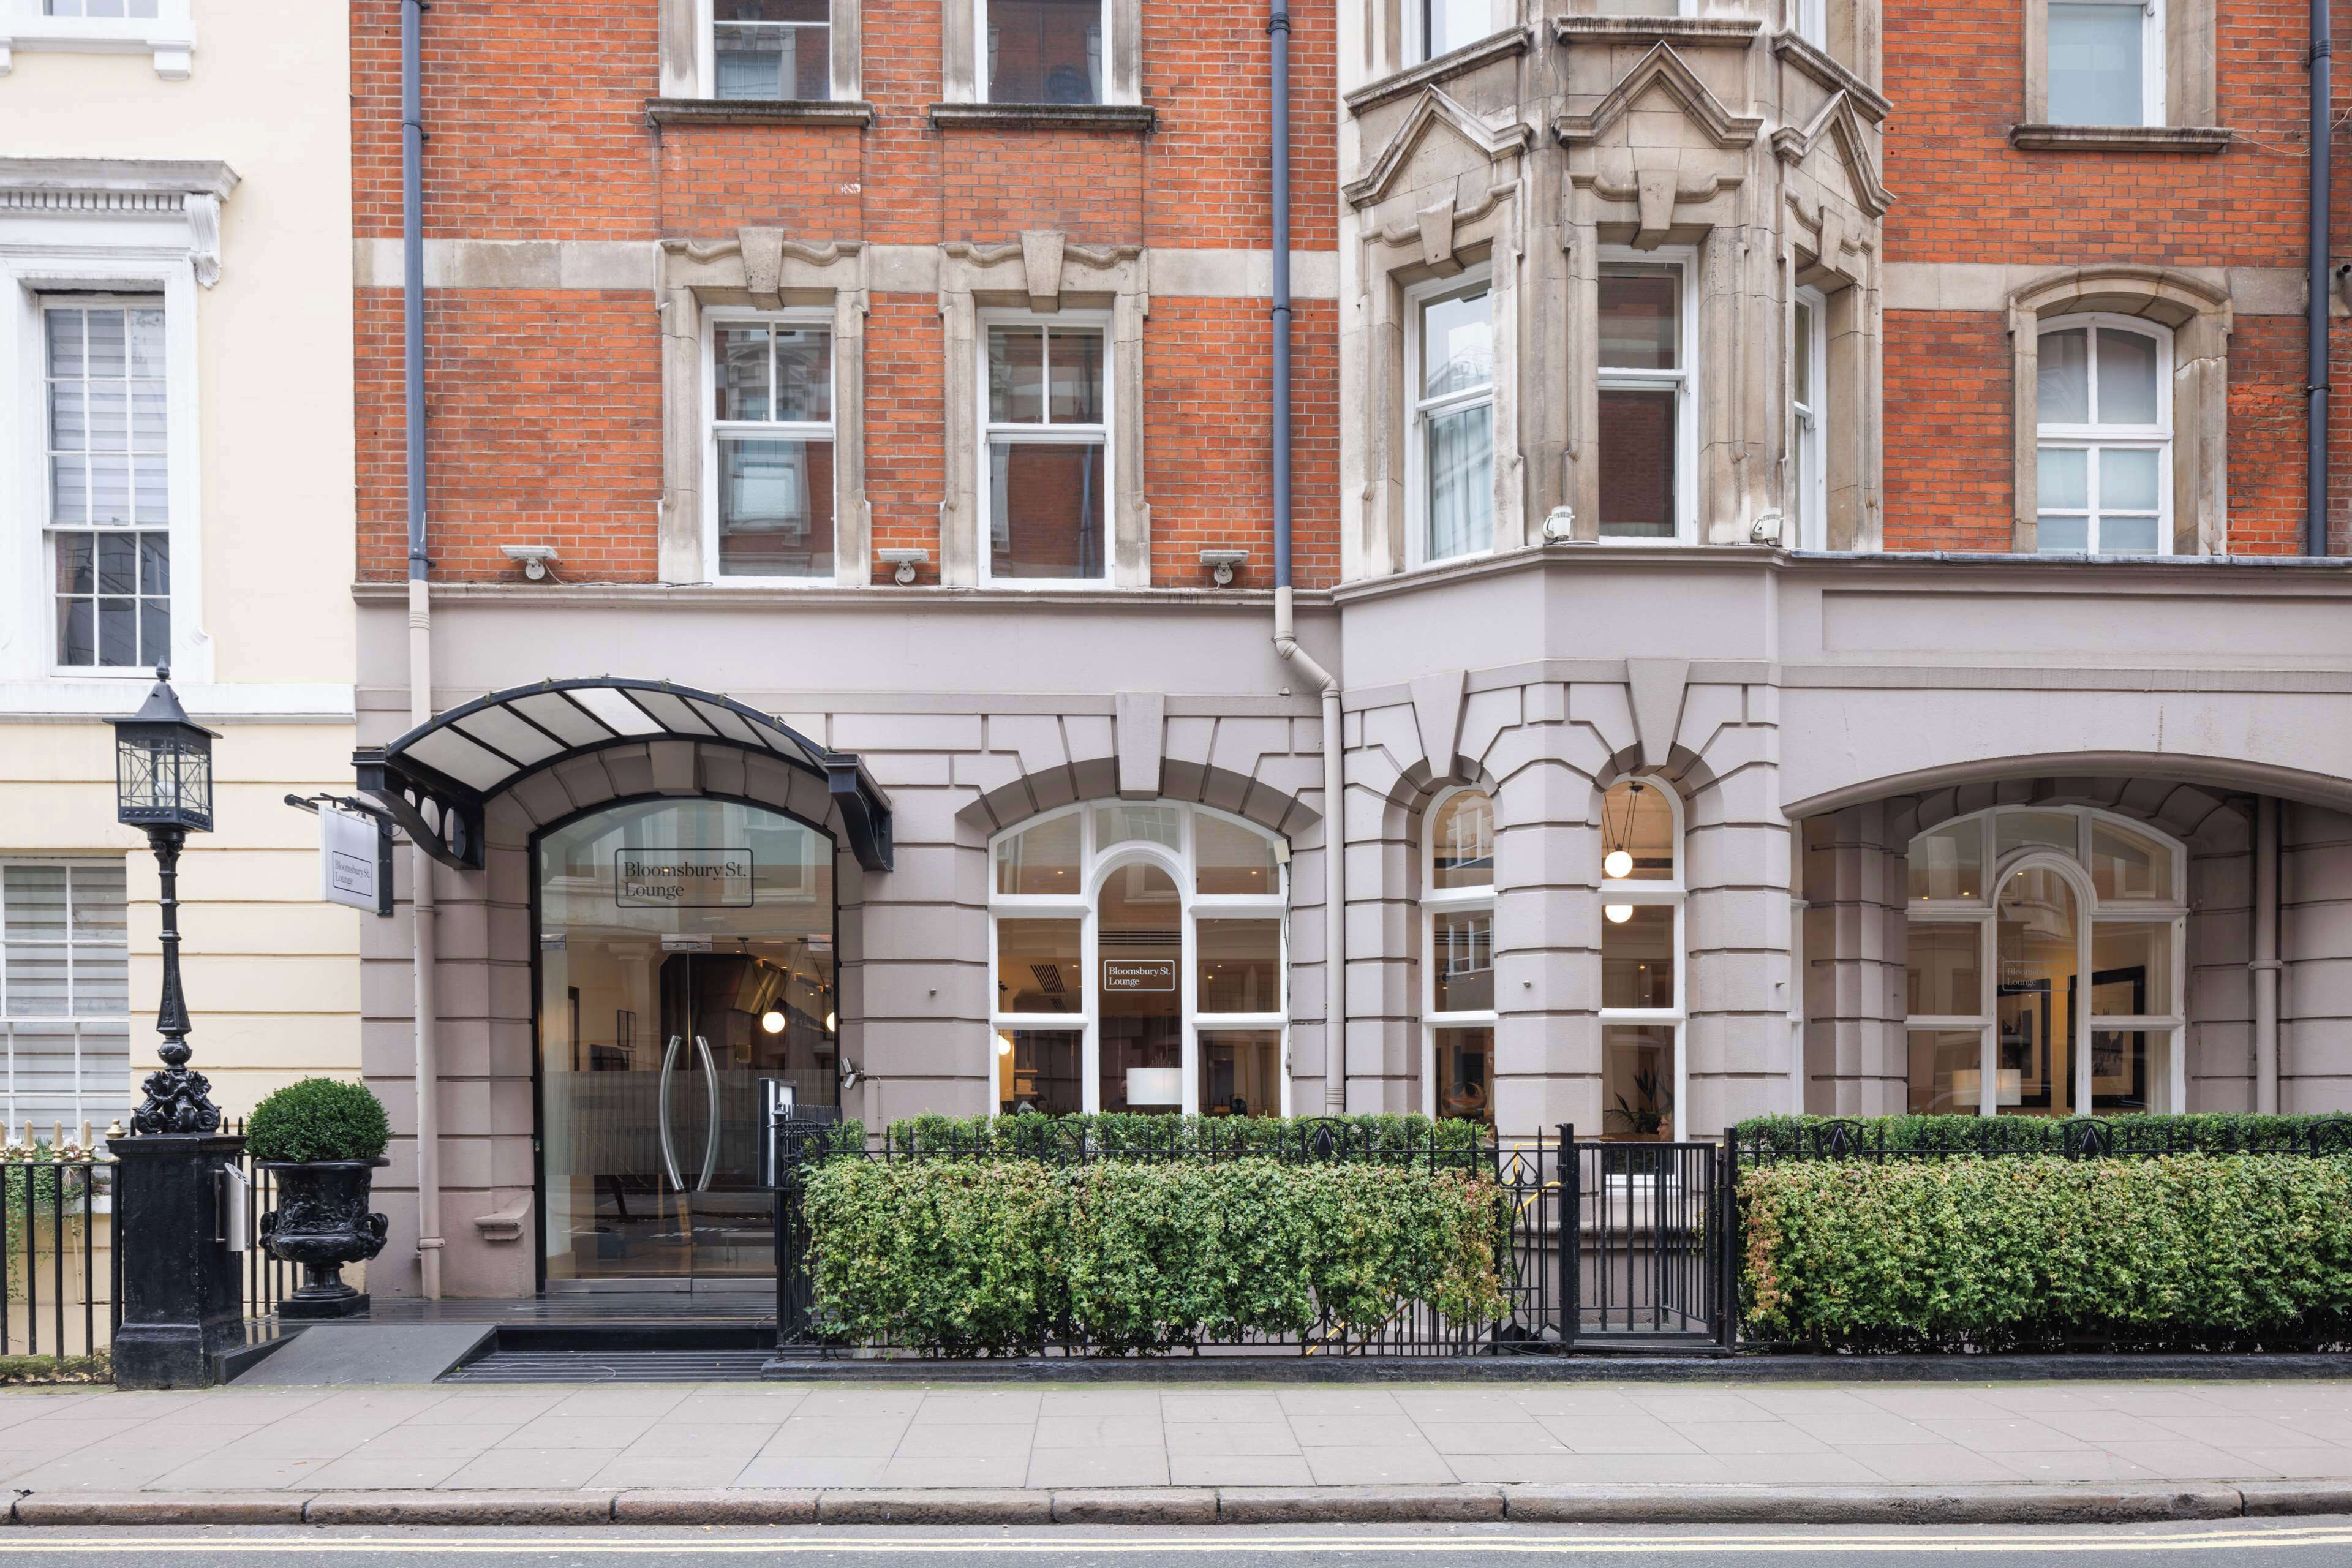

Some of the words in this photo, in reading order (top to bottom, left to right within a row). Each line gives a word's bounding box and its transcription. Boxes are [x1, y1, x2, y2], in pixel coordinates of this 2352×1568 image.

[335, 859, 363, 878] Bloomsbury
[624, 862, 722, 881] Bloomsbury
[725, 861, 746, 877] St.
[335, 871, 353, 887] Lounge
[624, 881, 685, 900] Lounge
[1109, 967, 1159, 977] Bloomsbury
[1160, 967, 1171, 975] St.
[1109, 977, 1140, 987] Lounge
[2007, 977, 2037, 987] Lounge
